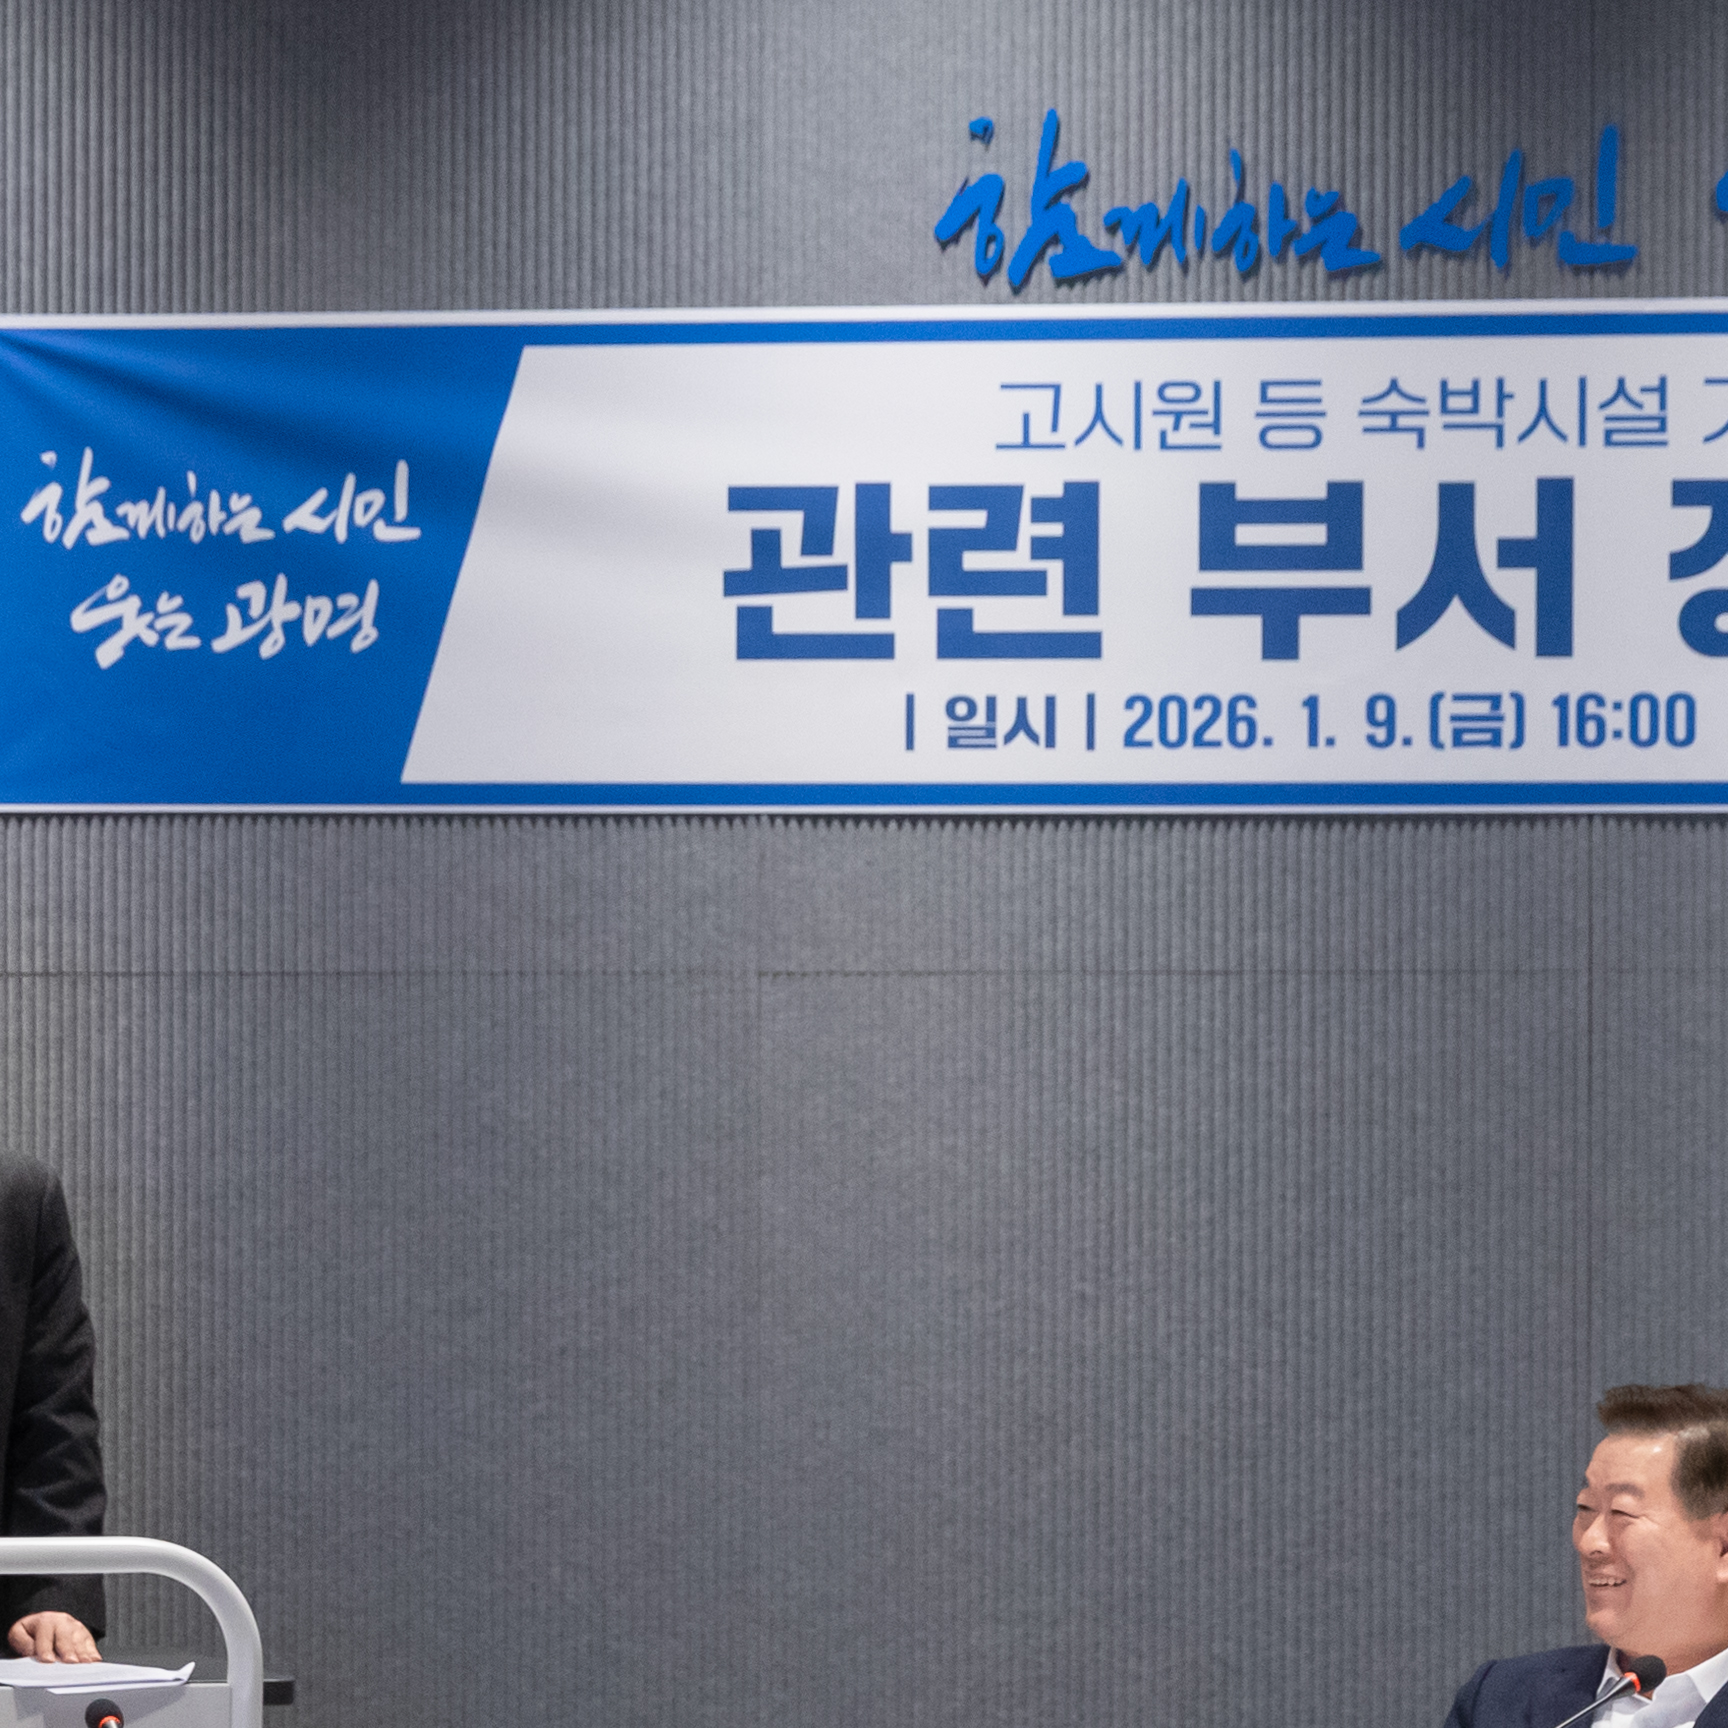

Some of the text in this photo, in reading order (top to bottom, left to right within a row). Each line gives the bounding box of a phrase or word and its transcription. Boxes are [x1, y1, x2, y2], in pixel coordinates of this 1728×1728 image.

[934, 108, 1381, 286] 함께하는
[1399, 124, 1638, 268] 시민
[995, 379, 1223, 452] 고시원
[1255, 378, 1328, 452] 등
[1358, 374, 1670, 451] 숙박시설
[20, 447, 422, 550] 함께하는 시민
[723, 481, 1103, 661] 관련
[1190, 477, 1574, 661] 부서
[70, 572, 380, 670] 웃는 광명
[944, 695, 1057, 750] 일시
[1122, 693, 1274, 750] 2026.
[1301, 693, 1336, 749] 1.
[1551, 691, 1697, 749] 16:00
